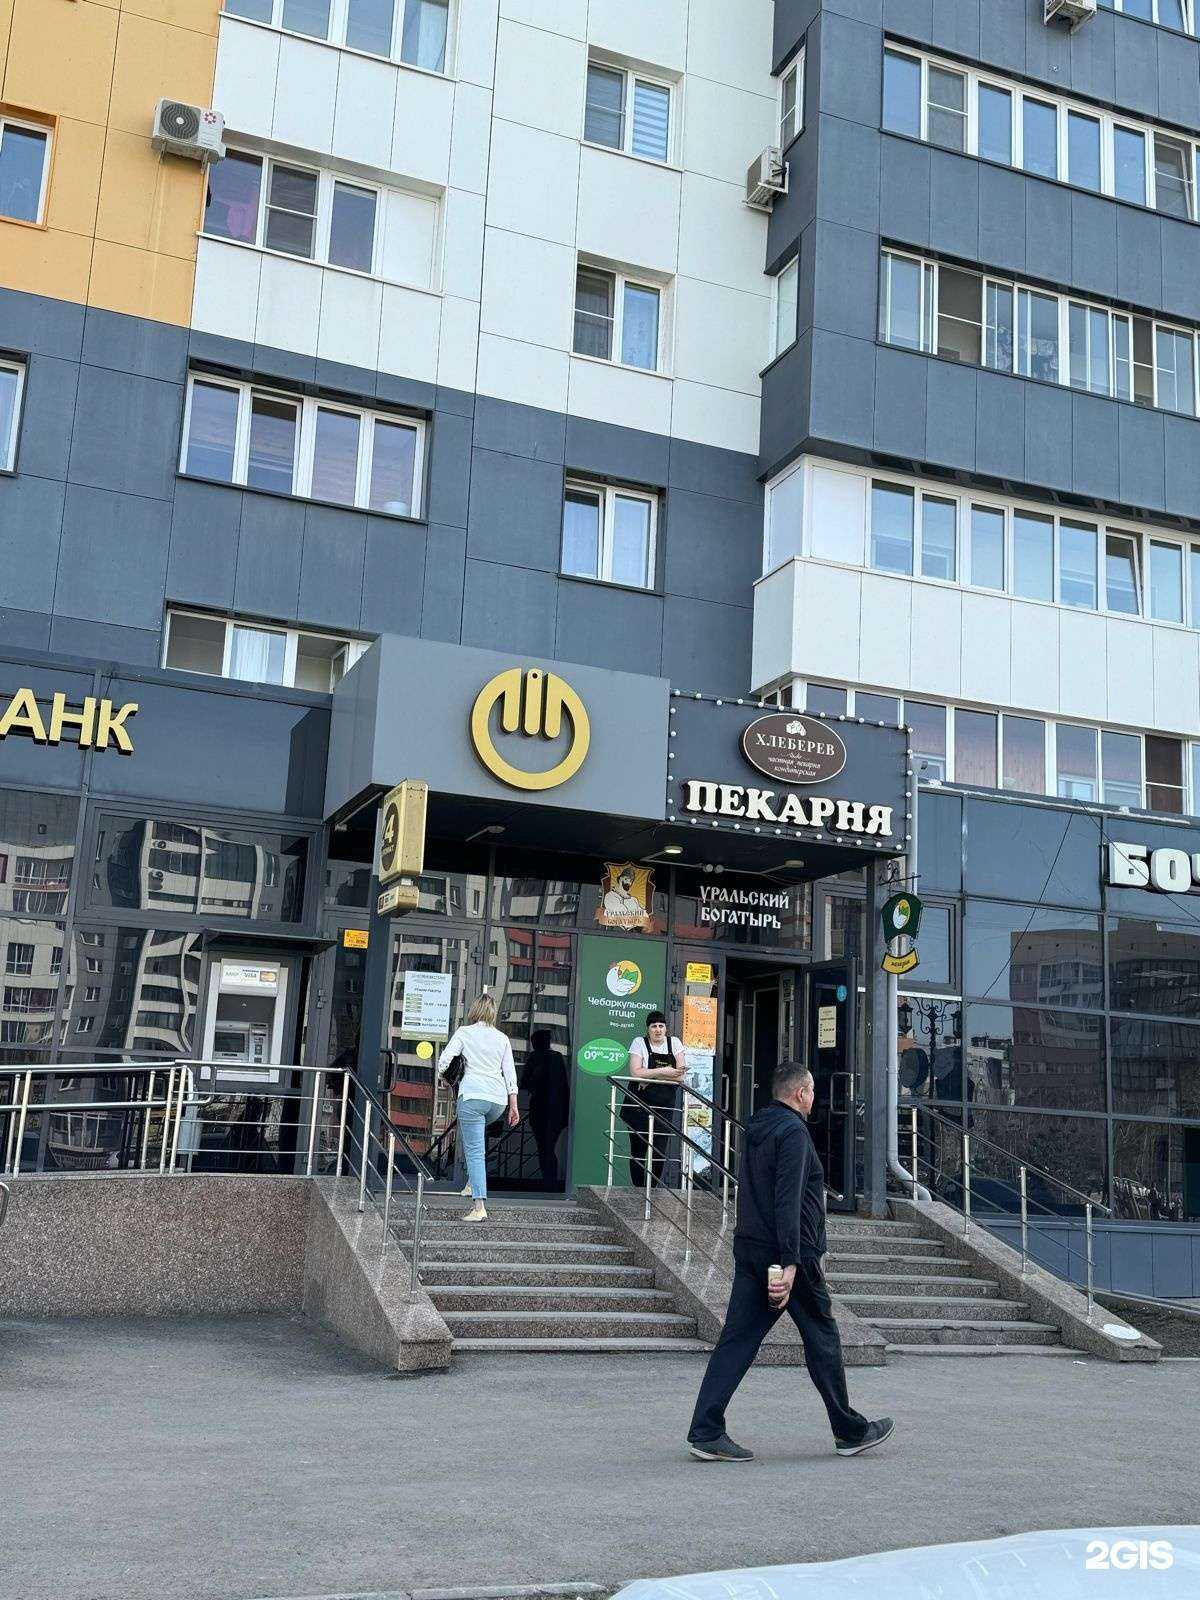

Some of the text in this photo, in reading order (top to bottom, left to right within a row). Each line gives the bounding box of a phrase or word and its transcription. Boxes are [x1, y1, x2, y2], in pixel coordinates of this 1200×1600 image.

[0, 688, 138, 752] АНК
[755, 732, 835, 756] ХЛЕБЕРЕВ
[686, 780, 894, 836] ПЕКАРНЯ
[1109, 841, 1200, 893] БО
[700, 885, 790, 909] УРАЛЬСКИЙ
[700, 906, 783, 929] БОГАТЫРЬ
[587, 996, 658, 1011] Чебаркульская
[608, 1009, 636, 1019] птица
